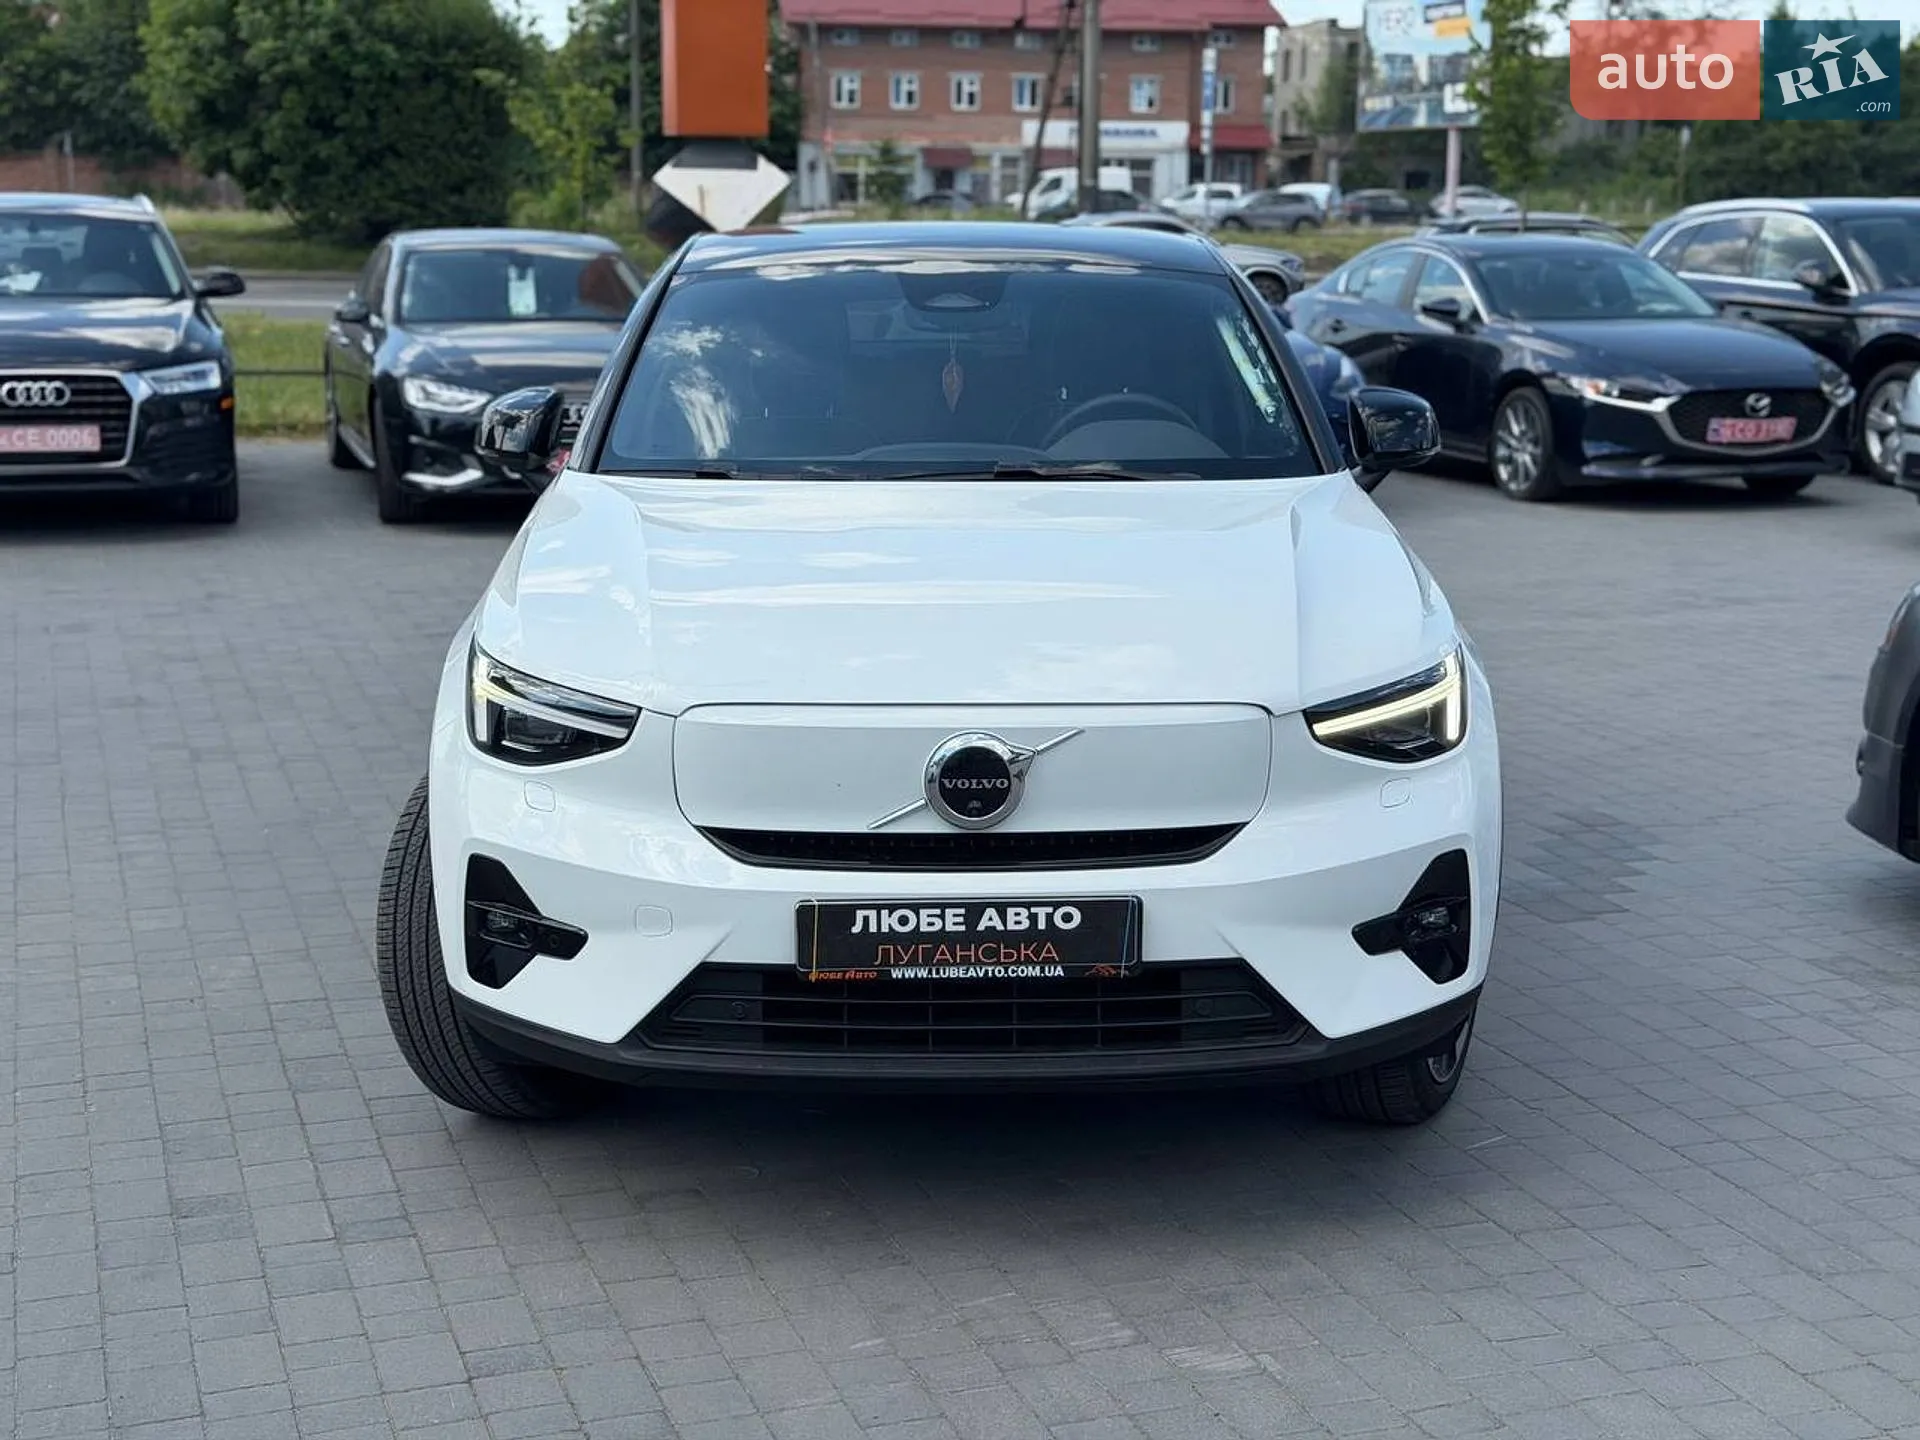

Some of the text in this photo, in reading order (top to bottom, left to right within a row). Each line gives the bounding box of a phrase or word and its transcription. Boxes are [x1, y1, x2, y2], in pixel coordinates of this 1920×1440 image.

[941, 778, 1009, 789] VOLVO
[851, 905, 1082, 934] ЛЮБЕ АВТО
[874, 941, 1059, 965] ЛУГАНСЬКА
[891, 965, 1065, 979] WWW.LUBEAVTO.COM.UA
